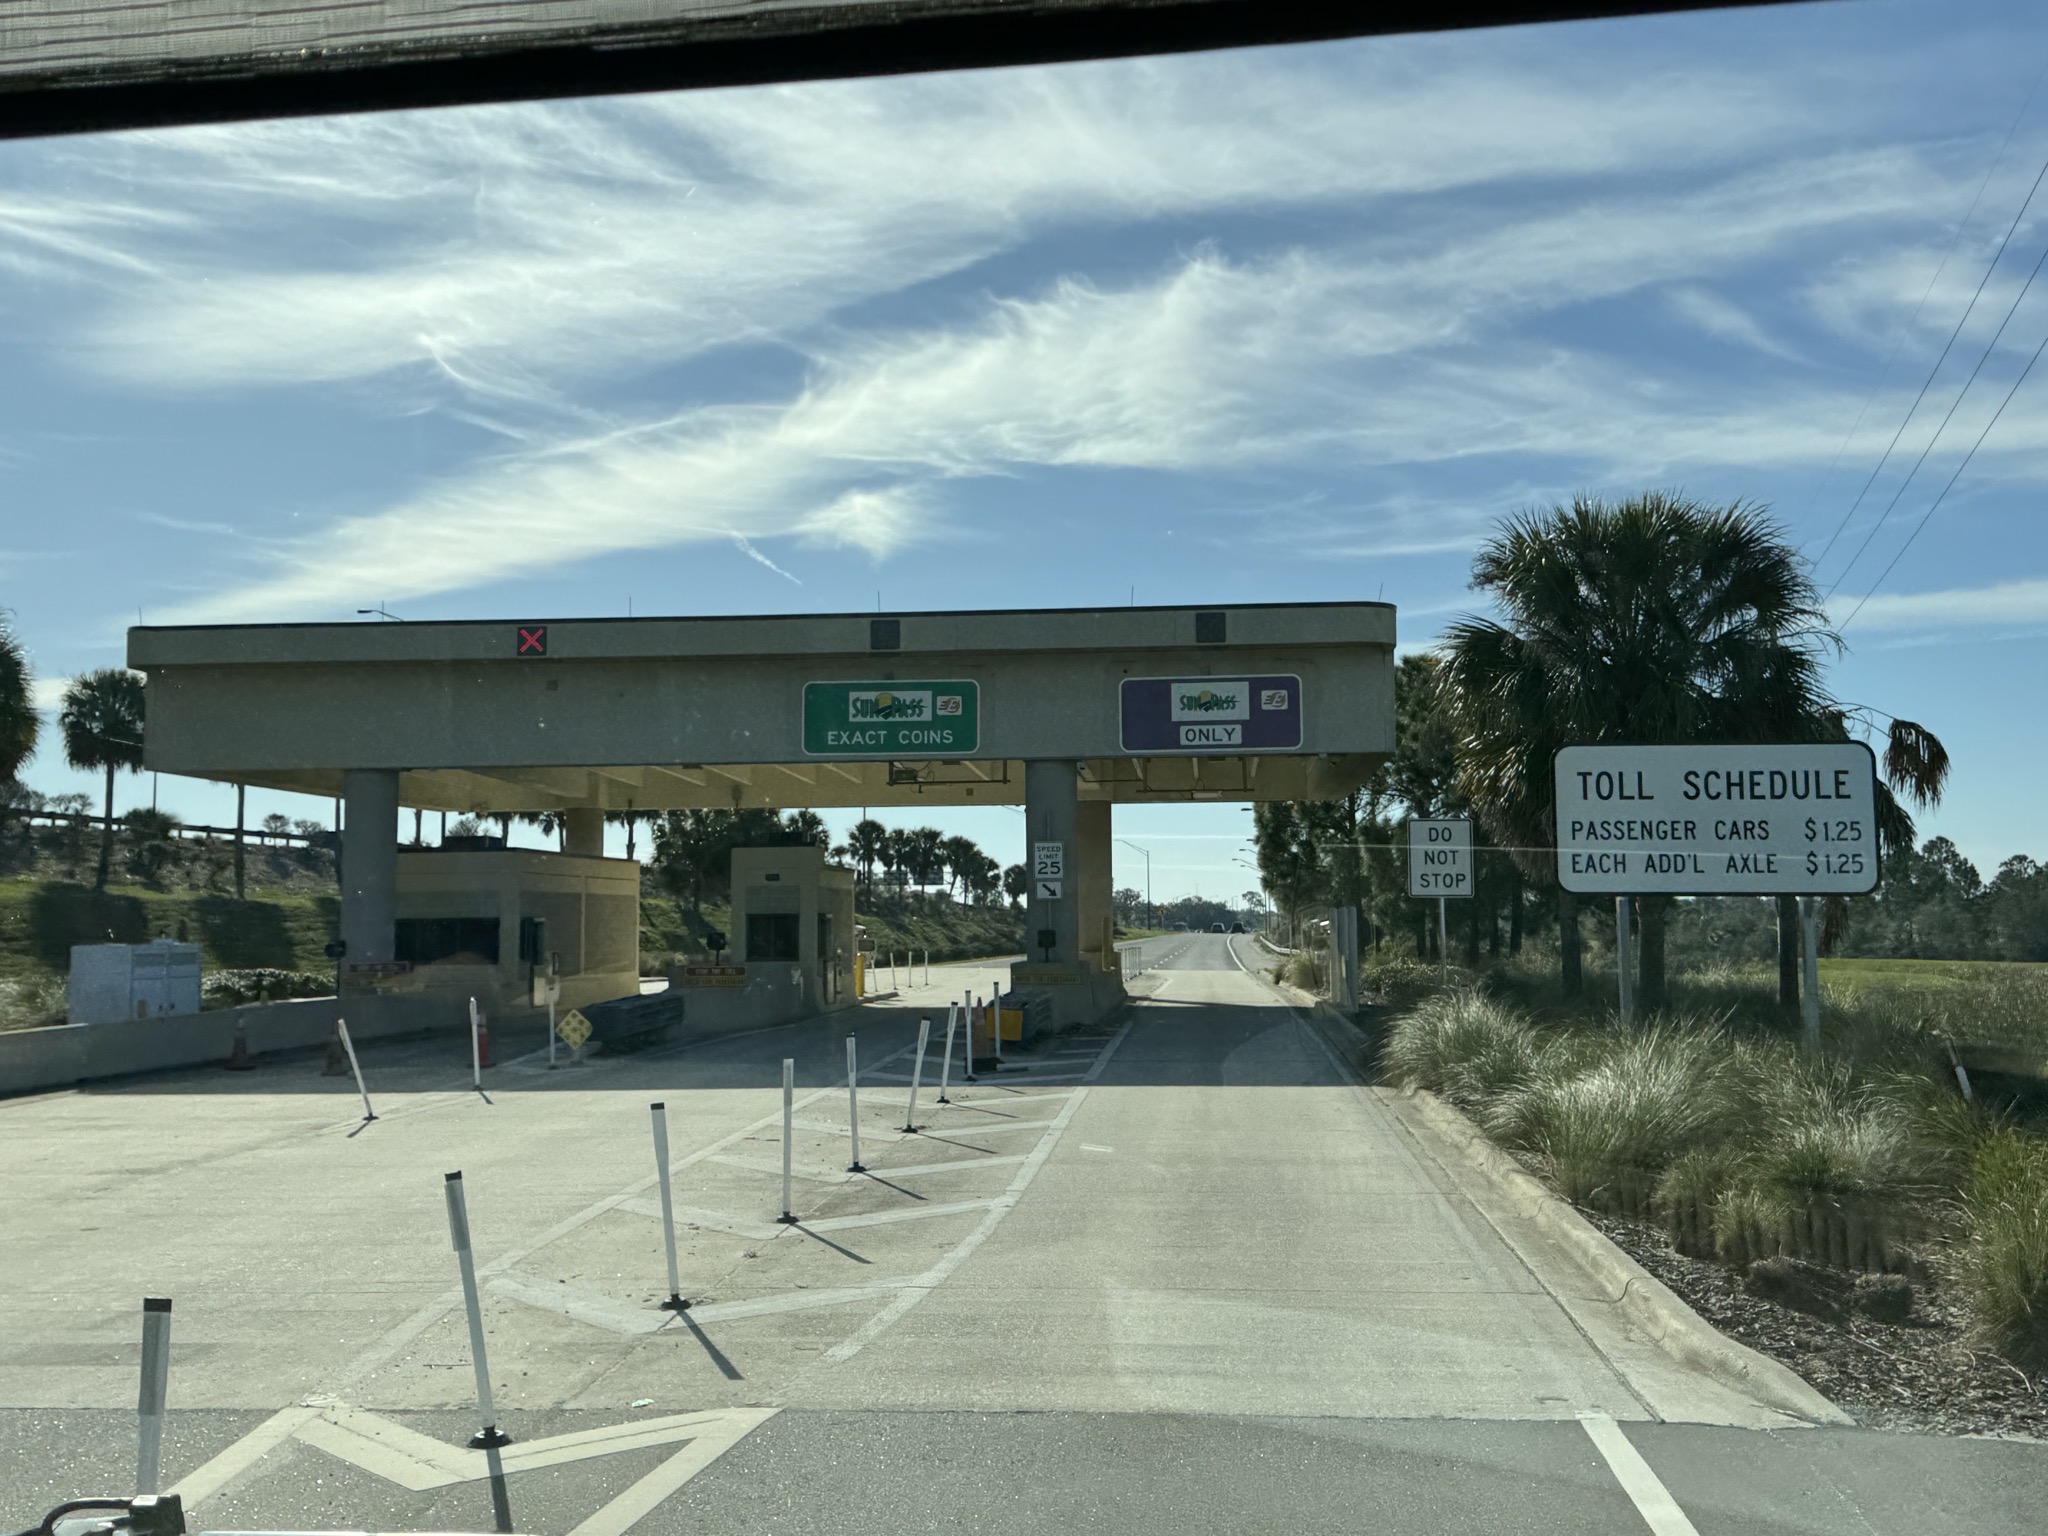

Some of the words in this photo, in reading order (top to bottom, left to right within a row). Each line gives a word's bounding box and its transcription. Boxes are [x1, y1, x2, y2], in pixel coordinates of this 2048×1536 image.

[827, 731, 887, 745] EXACT
[898, 730, 953, 744] COINS
[1185, 728, 1236, 742] ONLY
[1577, 771, 1654, 800] TOLL
[1683, 770, 1851, 800] SCHEDULE
[1428, 827, 1452, 842] DO
[1571, 820, 1696, 840] PASSENGER
[1715, 820, 1769, 840] CARS
[1424, 850, 1459, 865] NOT
[1572, 853, 1626, 873] EACH
[1644, 853, 1705, 873] ADD'L
[1726, 853, 1778, 873] AXLE
[1037, 861, 1061, 875] 25
[1420, 873, 1466, 888] STOP
